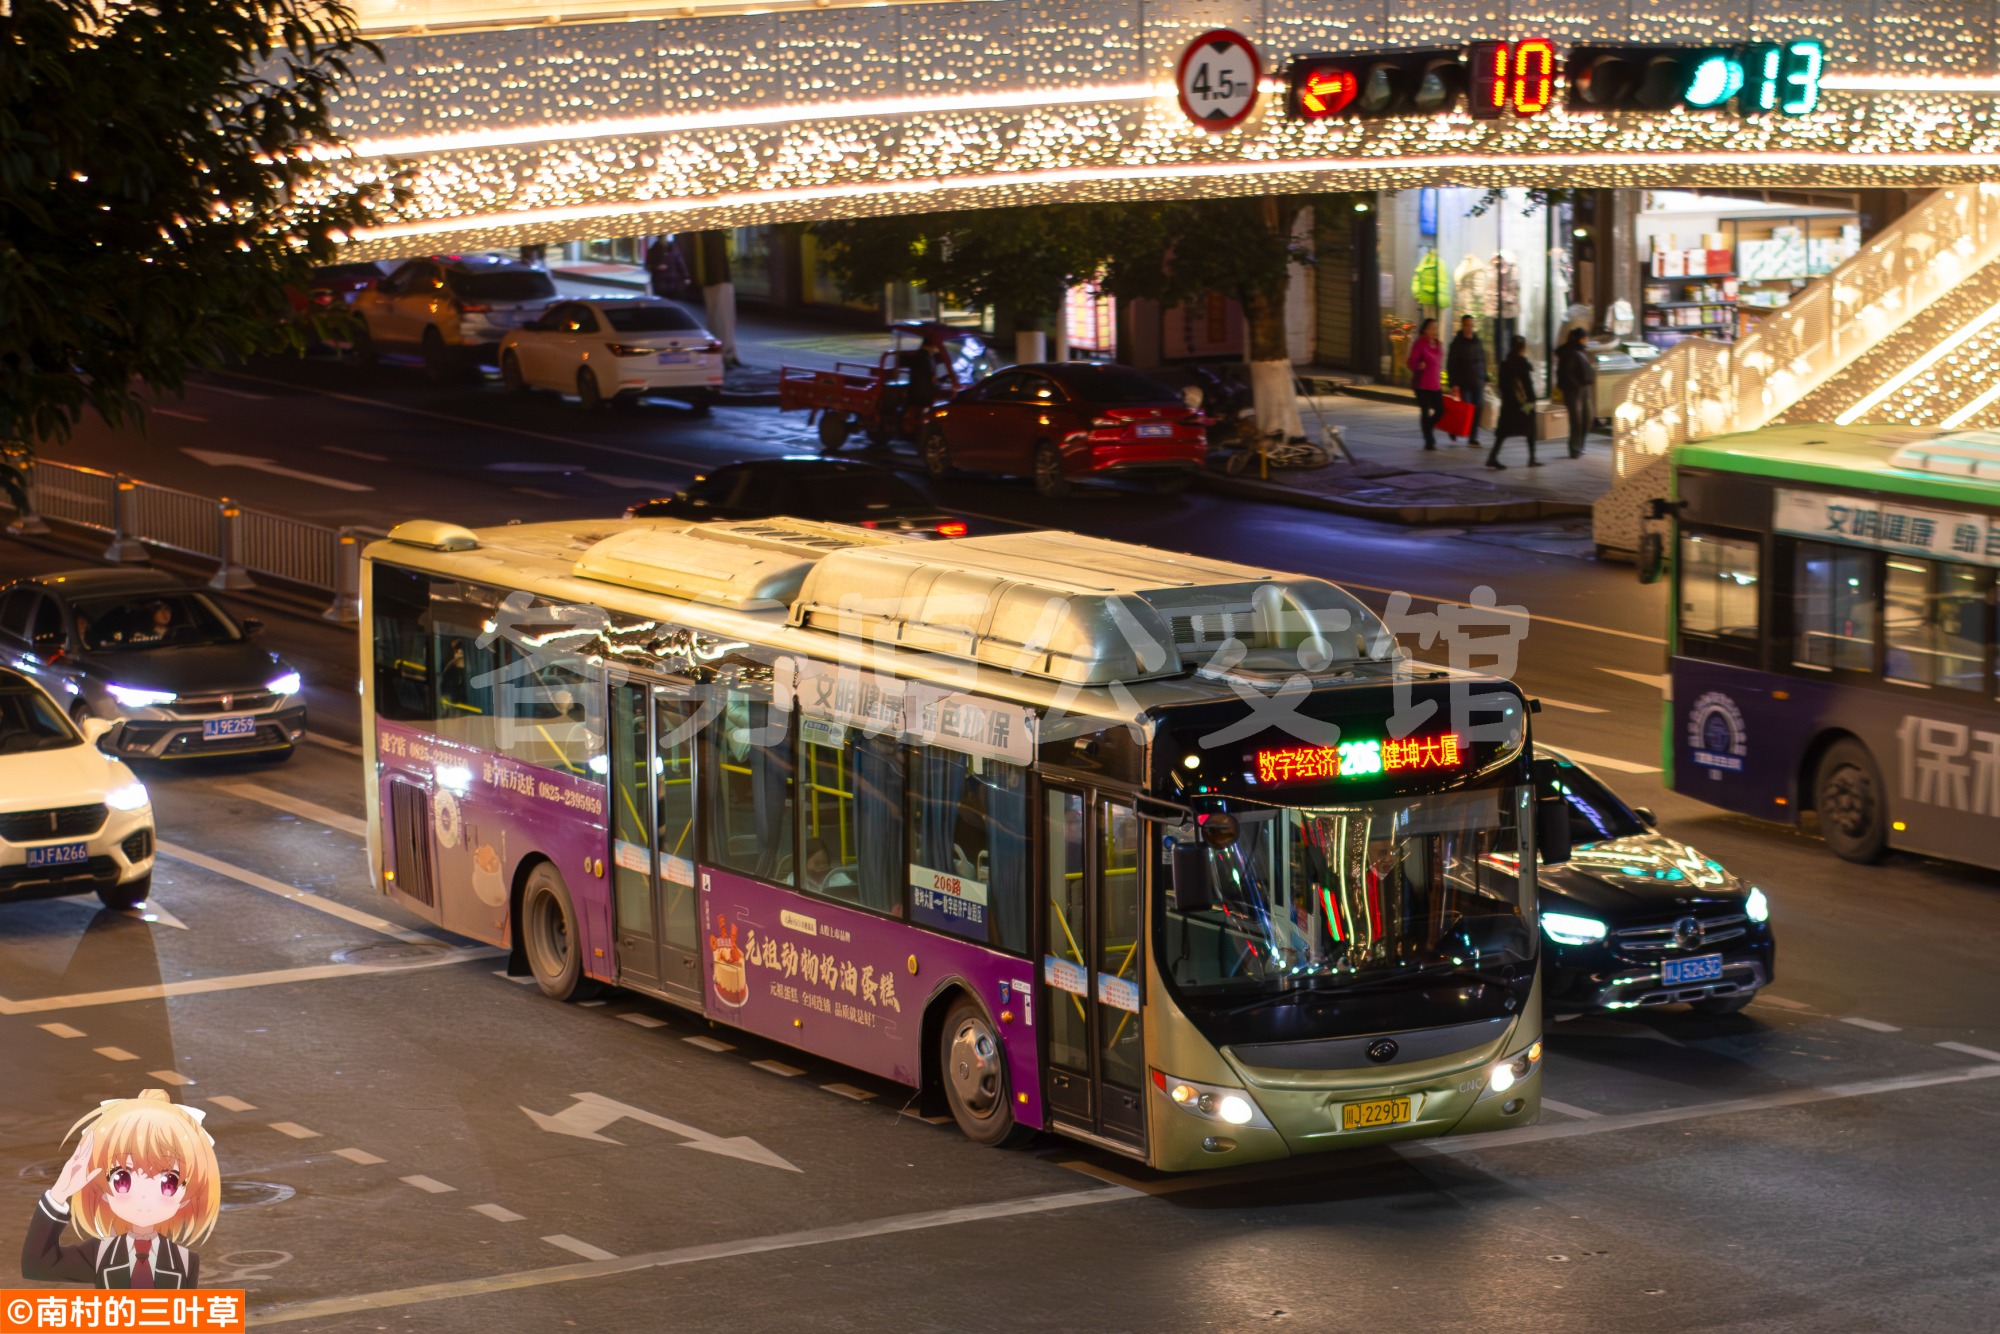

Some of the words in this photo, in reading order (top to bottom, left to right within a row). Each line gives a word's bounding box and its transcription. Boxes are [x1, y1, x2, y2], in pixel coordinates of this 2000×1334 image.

[1191, 62, 1250, 101] 4.5m
[1492, 41, 1552, 113] 10
[1758, 42, 1823, 115] 13
[814, 673, 901, 725] 文明健康
[1381, 734, 1460, 771] 健坤大厦
[30, 845, 86, 864] 川JFA266
[933, 874, 962, 897] 206路
[745, 929, 901, 1013] 元祖动物奶油蛋糕
